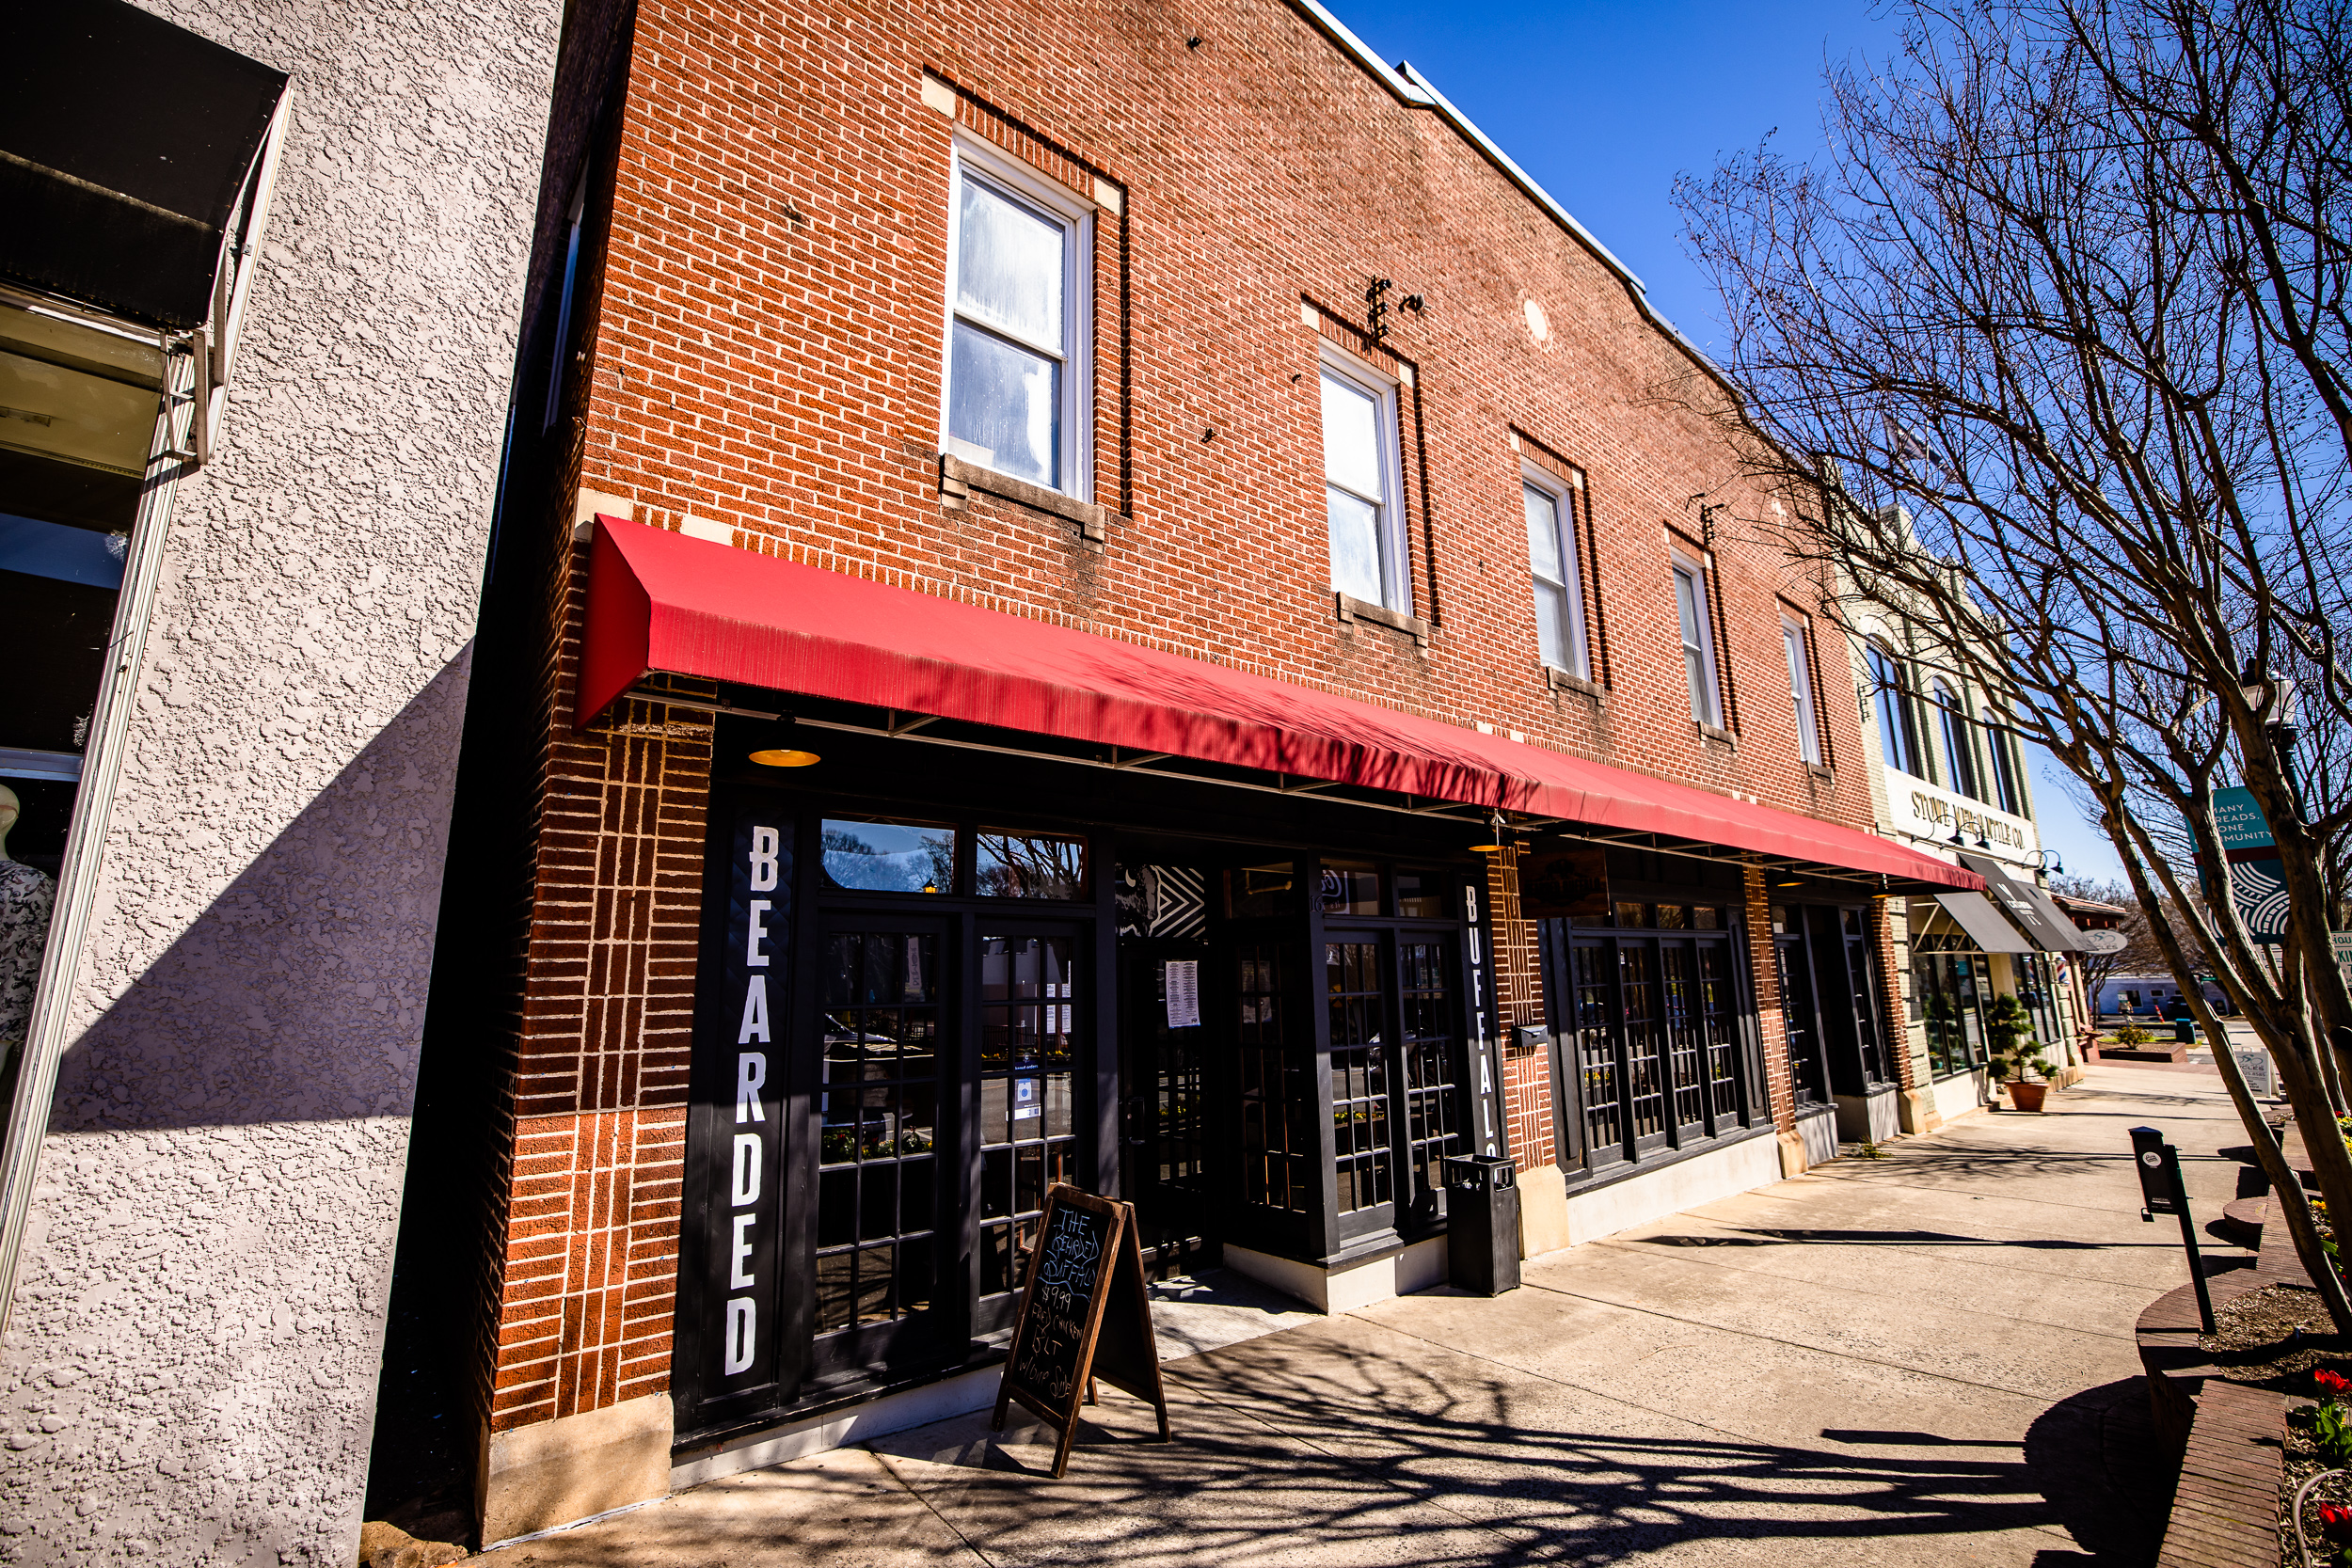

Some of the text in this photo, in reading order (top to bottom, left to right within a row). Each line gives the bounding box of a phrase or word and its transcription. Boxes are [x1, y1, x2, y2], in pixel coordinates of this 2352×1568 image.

[1912, 790, 1950, 828] STOWE
[2217, 824, 2245, 832] ONE
[724, 826, 779, 1377] BEARDED
[1054, 1208, 1090, 1235] THE
[1052, 1230, 1099, 1267] BEARDED
[1043, 1250, 1096, 1287] BUFFALO
[1041, 1284, 1072, 1313] $9.99
[1032, 1324, 1063, 1356] BLT
